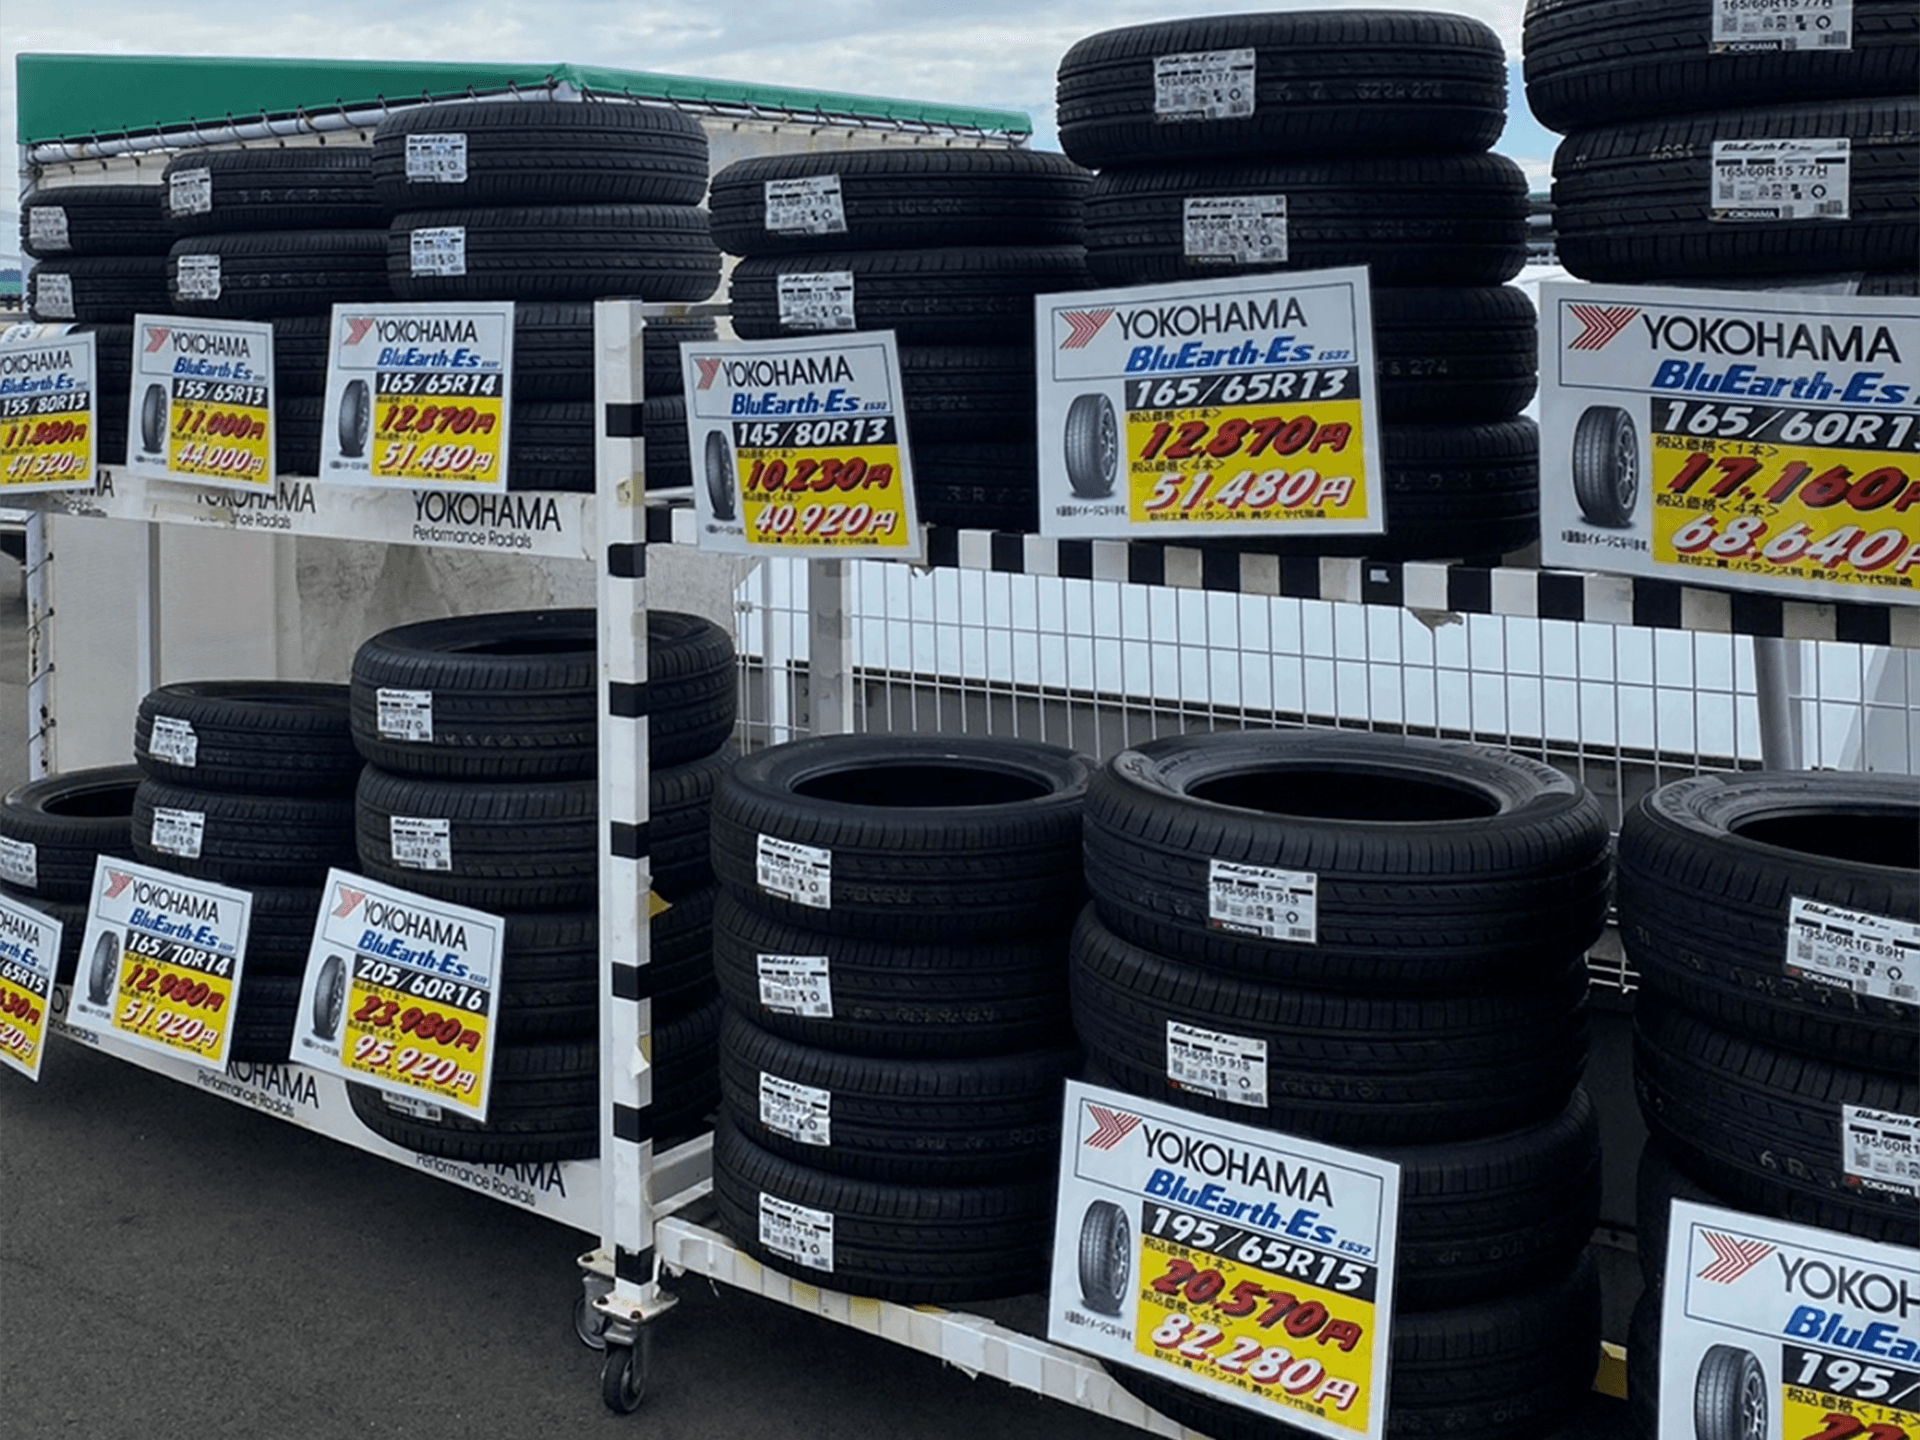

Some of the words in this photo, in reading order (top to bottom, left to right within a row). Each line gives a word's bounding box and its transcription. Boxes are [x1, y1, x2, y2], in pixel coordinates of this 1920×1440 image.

[1720, 165, 1794, 177] 165/60R15
[1799, 165, 1828, 176] 77H
[376, 319, 478, 343] YOKOHAMA
[1117, 297, 1307, 341] YOKOHAMA
[172, 331, 251, 358] YOKOHAMA
[1642, 314, 1903, 364] YOKOHAMA
[0, 350, 73, 374] OKOHAMA
[722, 355, 854, 387] YOKOHAMA
[176, 379, 265, 405] 155/65R13
[380, 373, 497, 395] 165/65R14
[1135, 369, 1348, 408] 165/65R13
[3, 392, 87, 416] 155/80R13
[739, 418, 888, 446] 145/80R13
[413, 490, 561, 532] YOKOHAMA
[413, 524, 486, 546] Performance
[488, 529, 532, 549] Radials
[132, 879, 219, 924] YOKOHAMA
[364, 898, 468, 951] YOKOHAMA
[128, 933, 231, 976] 165/70R14
[1800, 926, 1872, 952] 195/60R16
[1875, 944, 1905, 961] 89H
[357, 958, 483, 1011] 205/60R16
[1142, 1124, 1334, 1208] YOKOHAMA
[492, 1177, 536, 1207] Radials
[1151, 1207, 1369, 1292] 195/65R15
